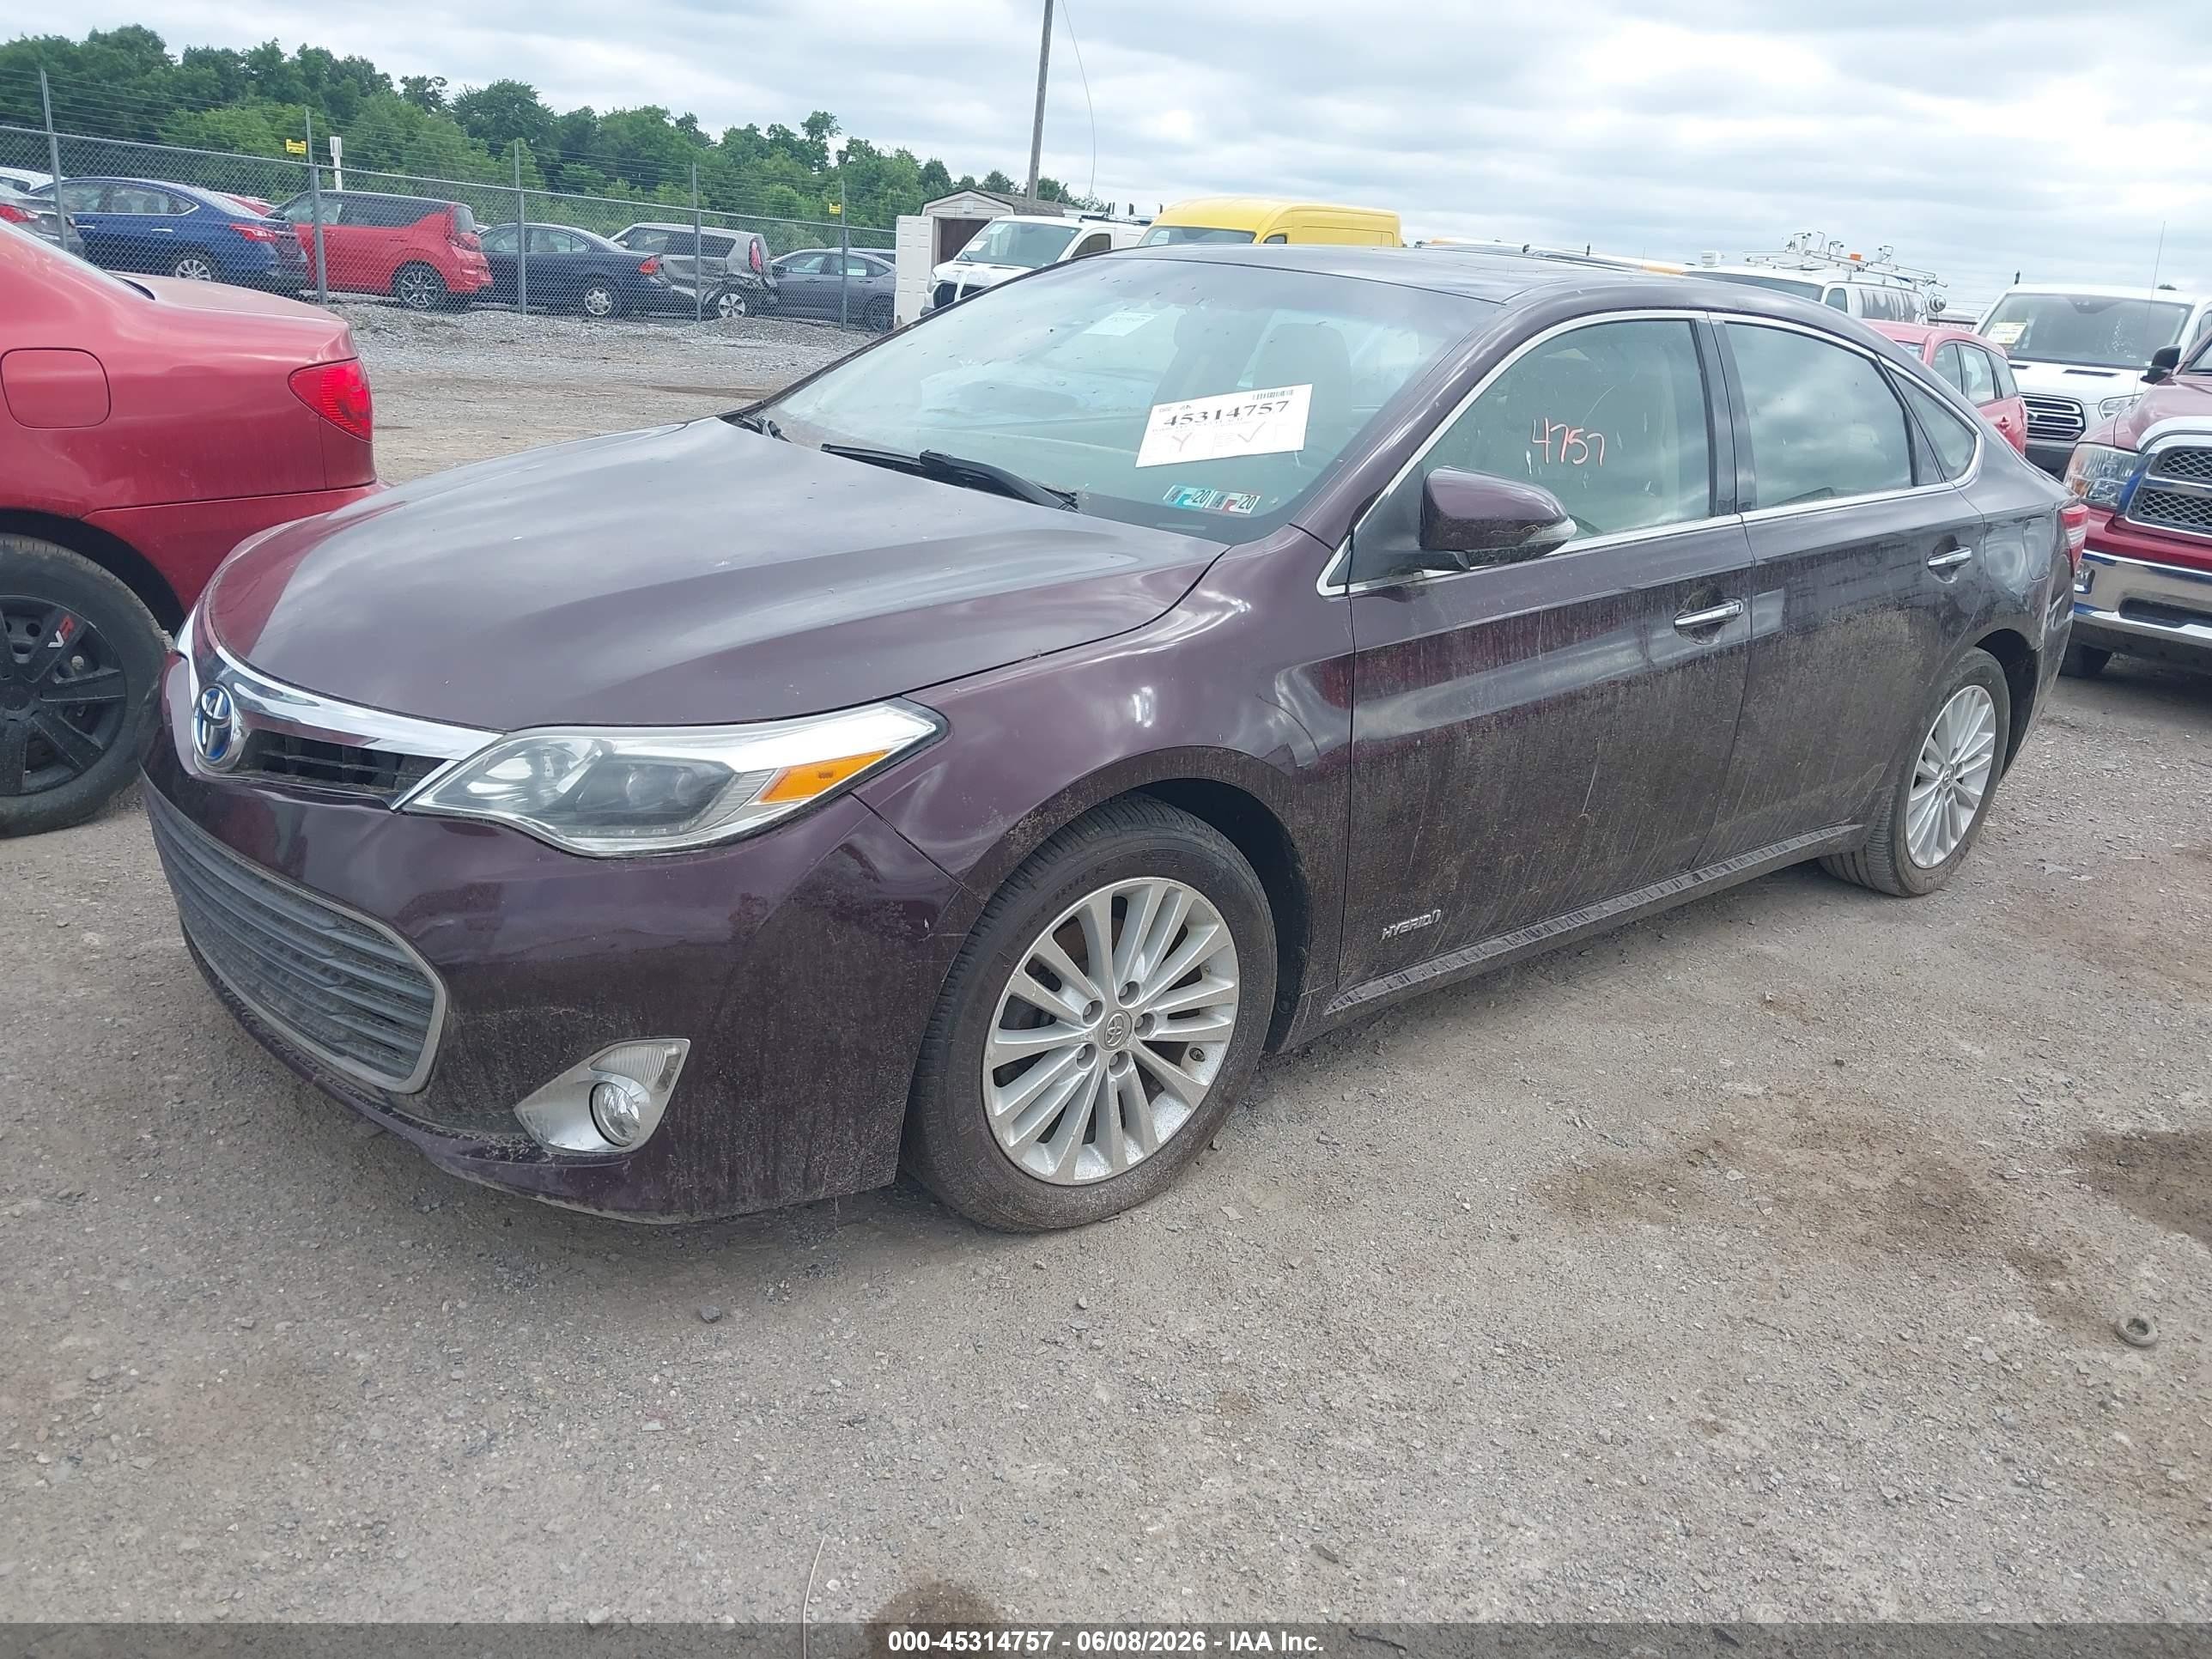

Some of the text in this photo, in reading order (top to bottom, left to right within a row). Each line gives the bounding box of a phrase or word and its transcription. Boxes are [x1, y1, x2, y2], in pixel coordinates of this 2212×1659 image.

[1164, 400, 1290, 426] 45314757
[1532, 417, 1606, 466] 4757
[1379, 913, 1434, 943] HYBRID
